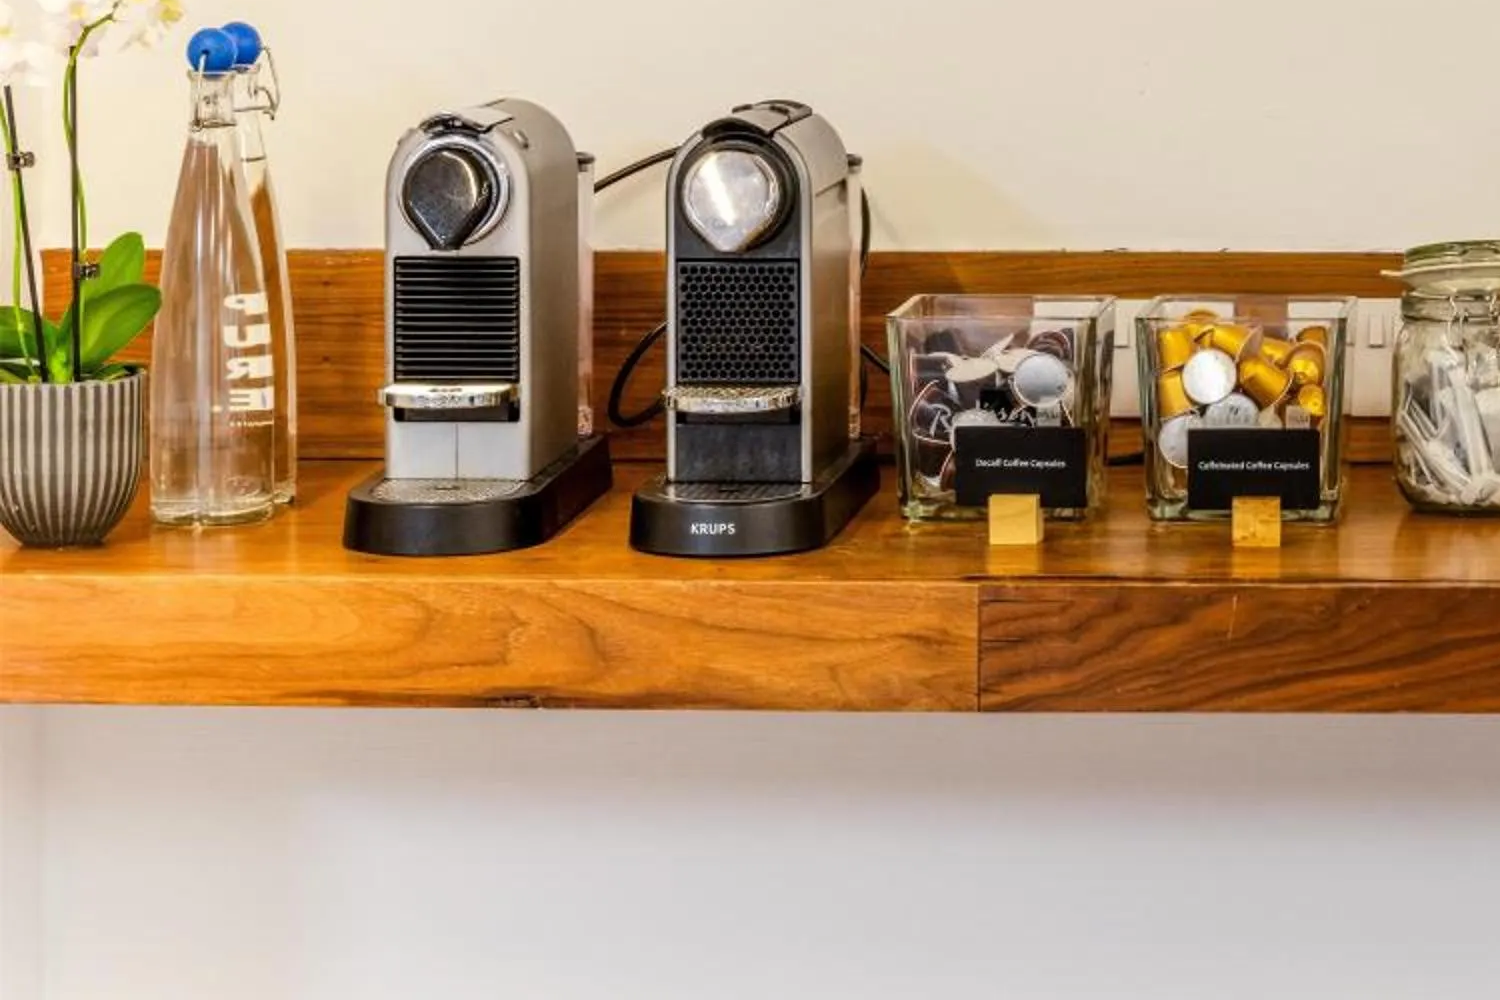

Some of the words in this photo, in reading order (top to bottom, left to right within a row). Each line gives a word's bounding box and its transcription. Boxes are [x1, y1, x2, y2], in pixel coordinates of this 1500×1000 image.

[1003, 458, 1029, 467] Coffee
[1031, 459, 1066, 469] Capsules
[1246, 460, 1273, 470] Coffee
[1274, 460, 1310, 471] Capsules
[691, 523, 736, 535] KRUPS
